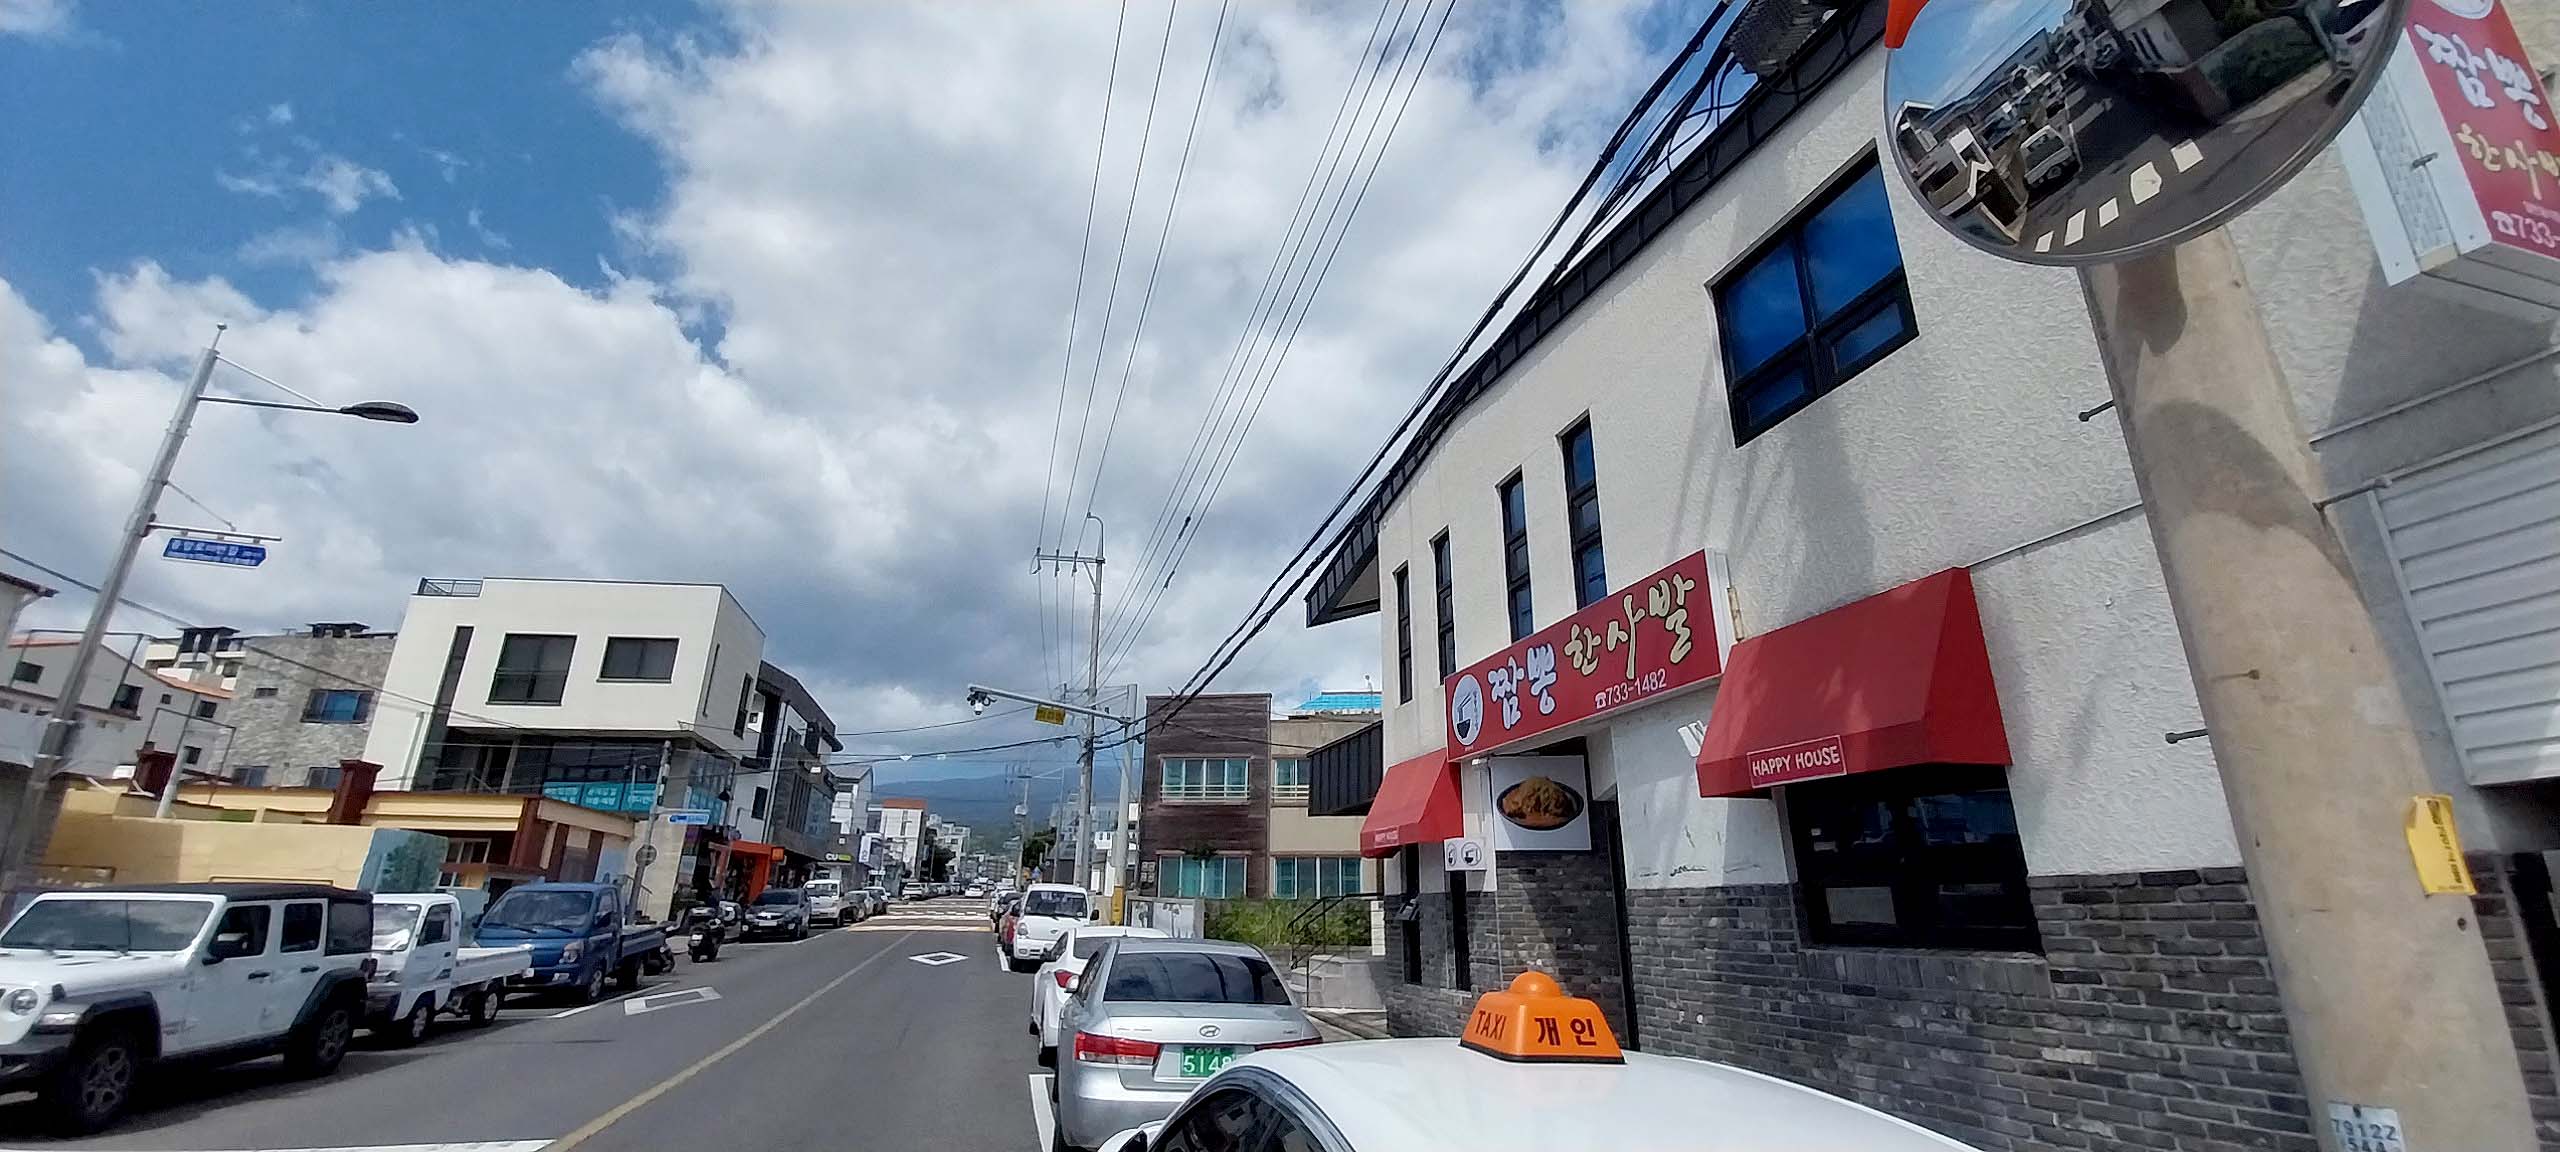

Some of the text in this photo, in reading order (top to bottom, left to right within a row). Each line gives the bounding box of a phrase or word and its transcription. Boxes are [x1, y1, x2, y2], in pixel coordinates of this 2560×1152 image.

[2413, 23, 2549, 131] 짬뽕
[1488, 643, 1557, 729] 짬뽕
[1564, 573, 1696, 680] 한사발
[1606, 667, 1667, 706] 733-1482
[1752, 745, 1841, 777] HAPPY HOUSE
[1474, 1010, 1507, 1041] TAXI
